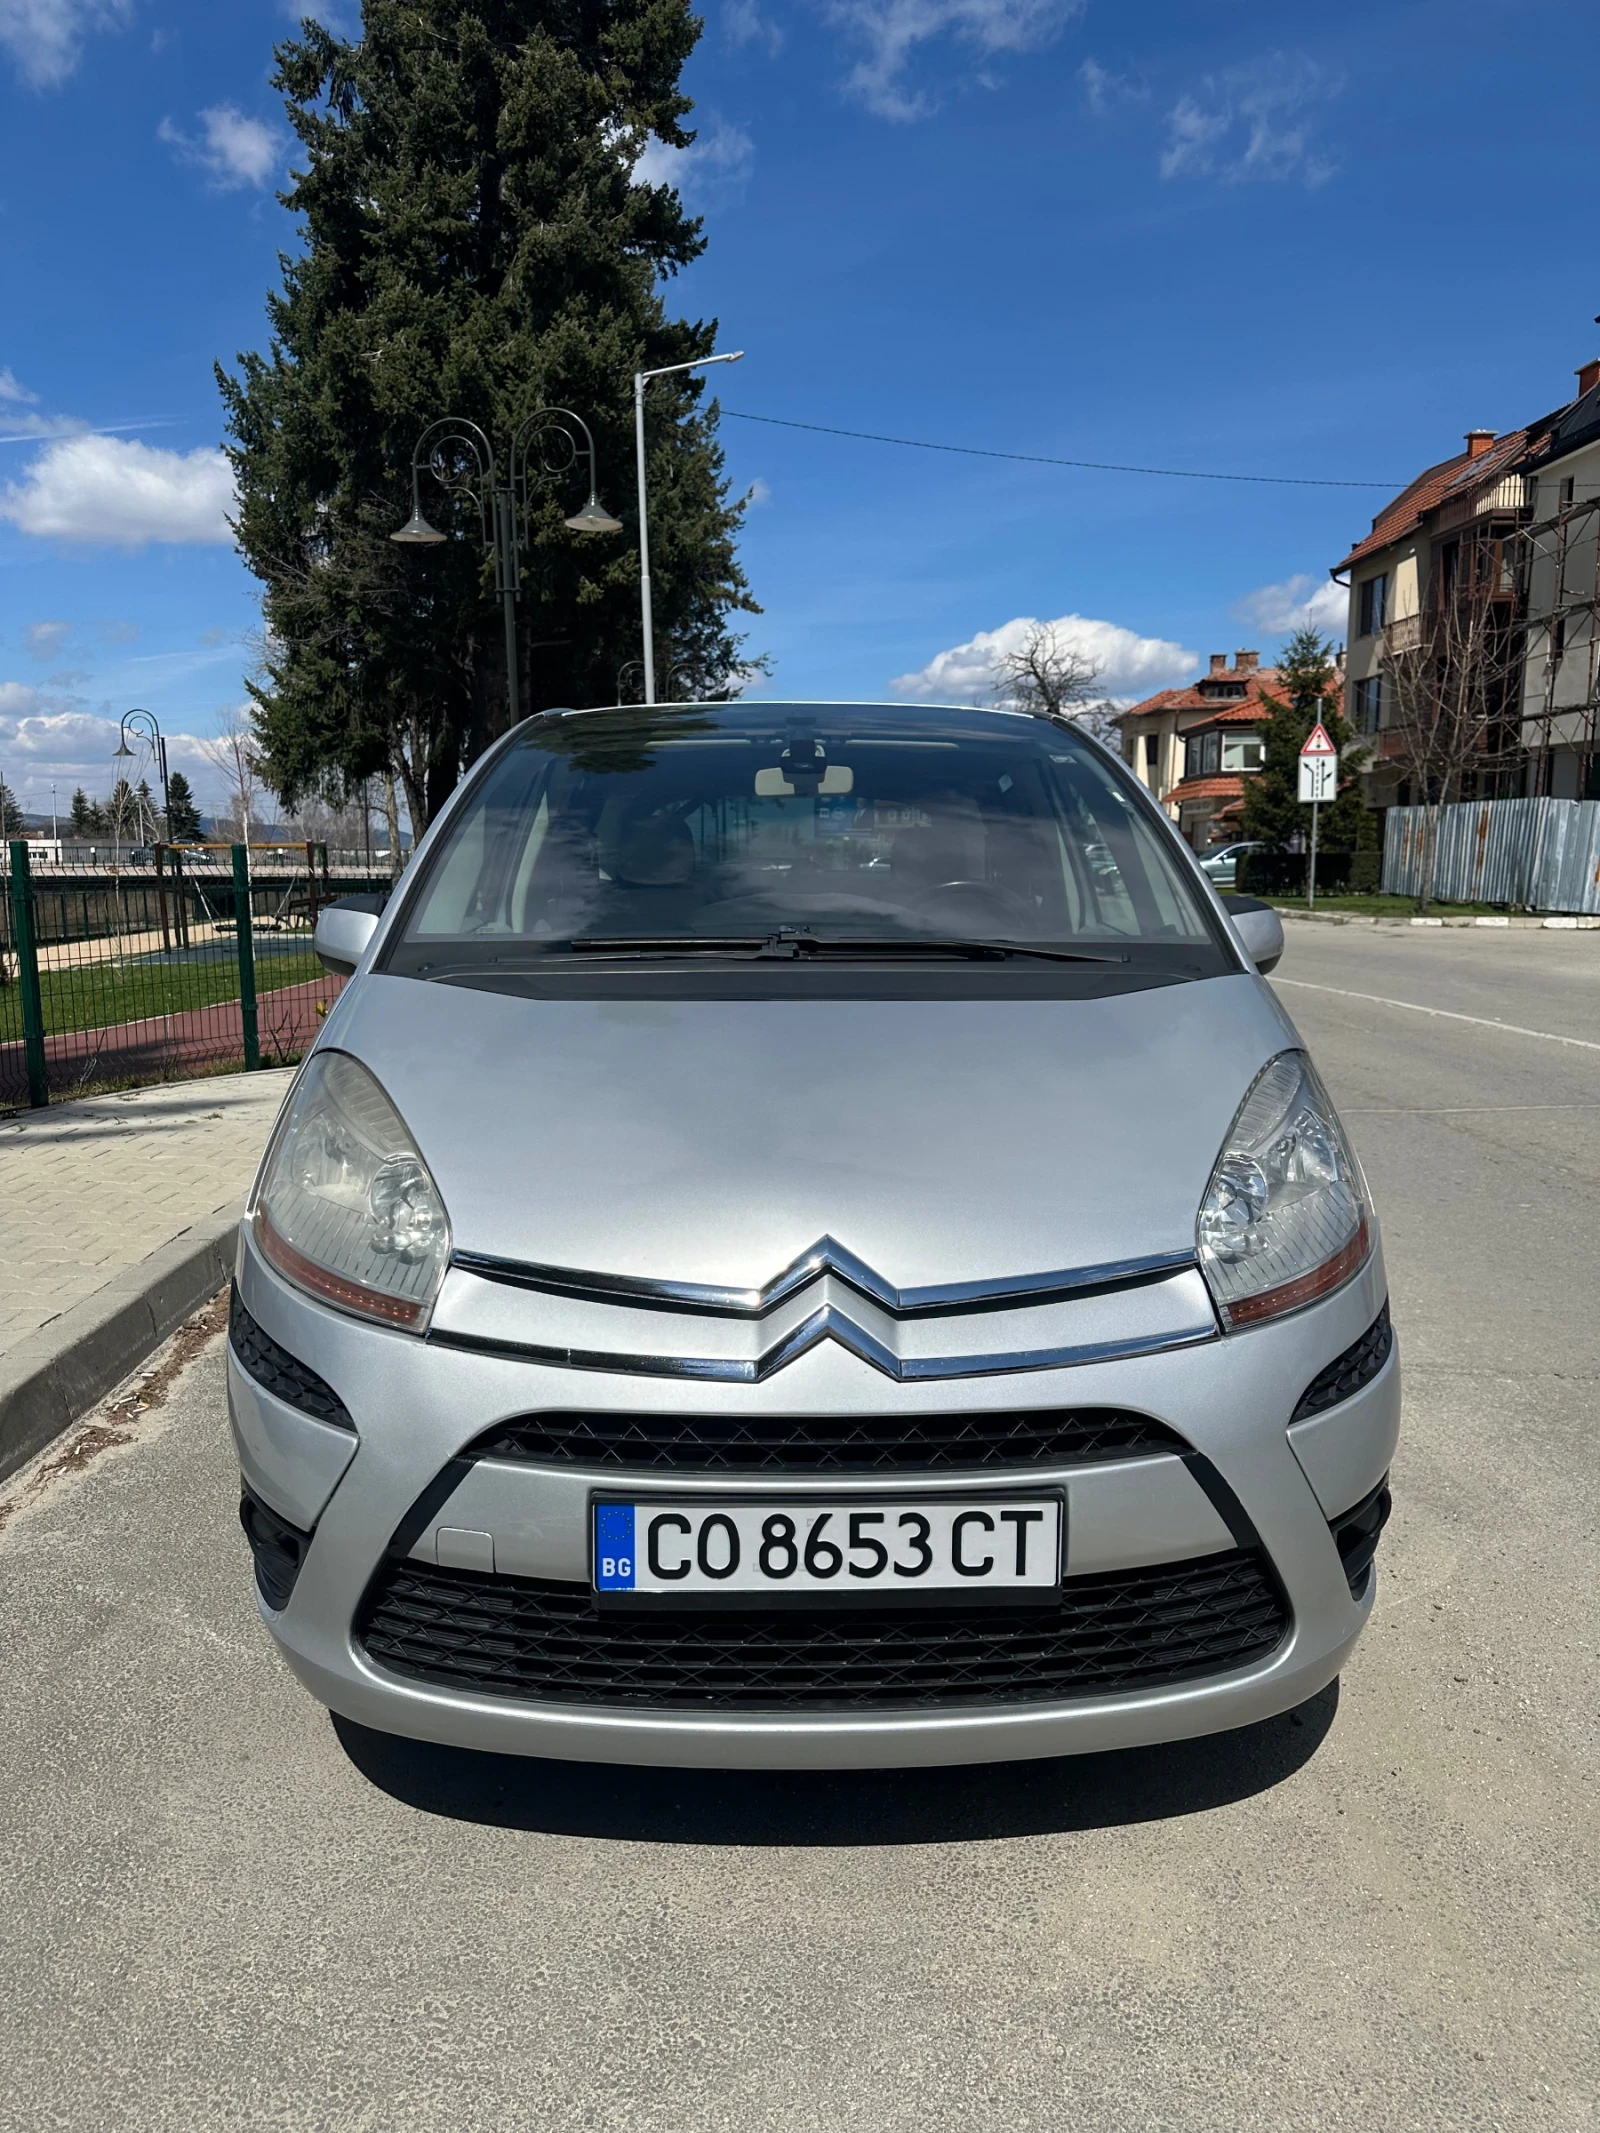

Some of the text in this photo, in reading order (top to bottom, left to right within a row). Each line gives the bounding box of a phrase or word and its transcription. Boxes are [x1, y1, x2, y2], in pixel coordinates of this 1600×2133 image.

[602, 1557, 631, 1577] BG
[758, 1512, 933, 1580] 8653
[951, 1510, 1044, 1577] CT
